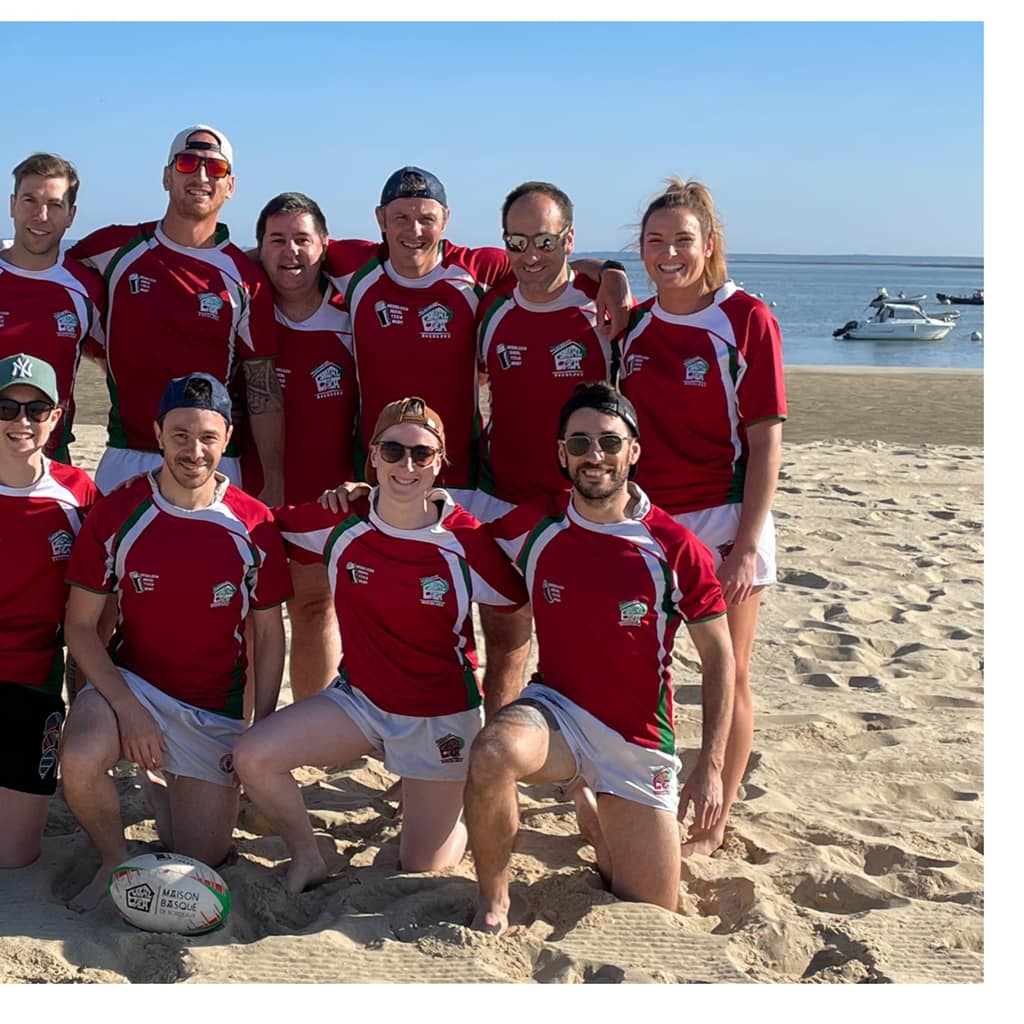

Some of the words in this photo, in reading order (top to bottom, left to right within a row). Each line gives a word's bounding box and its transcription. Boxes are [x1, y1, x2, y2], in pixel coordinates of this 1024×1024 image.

[12, 357, 33, 377] NY
[162, 889, 200, 902] MAISON
[160, 899, 197, 912] BASQUE
